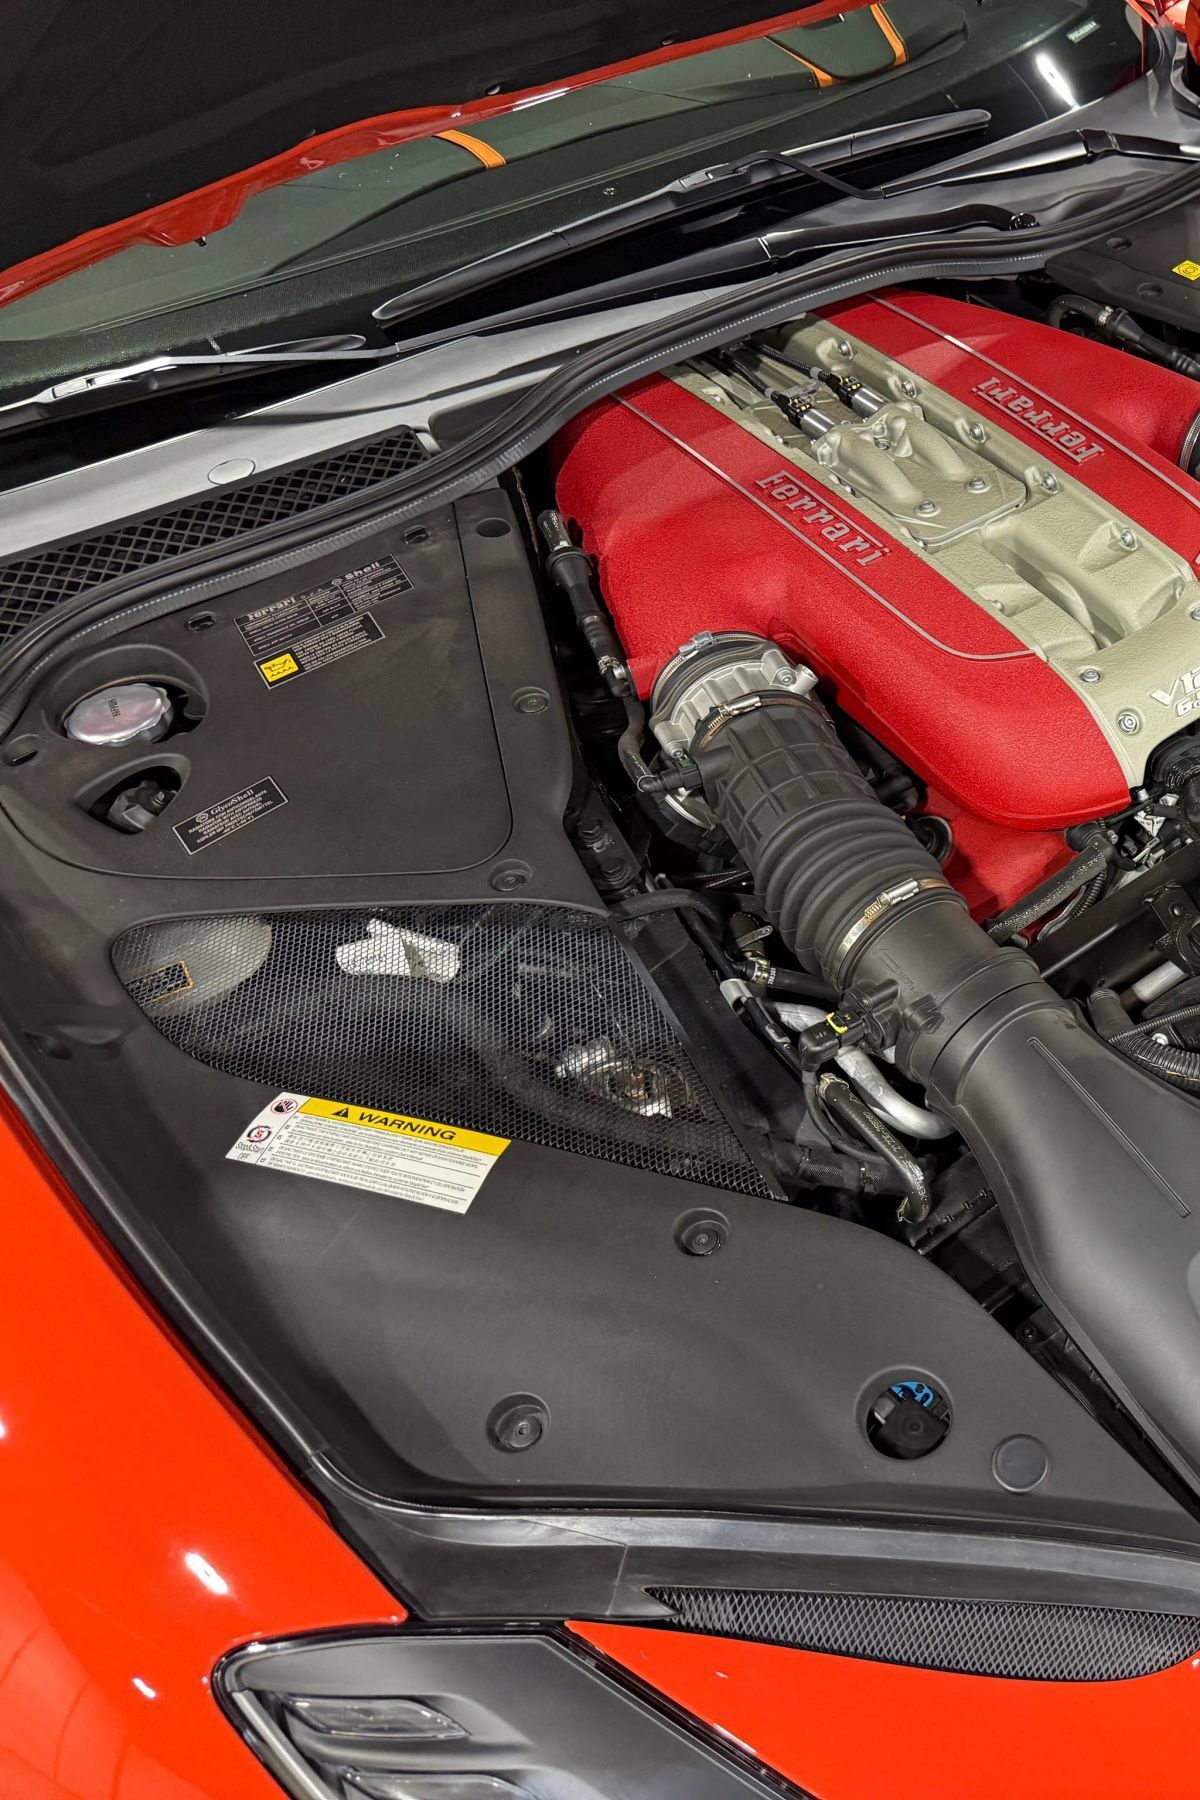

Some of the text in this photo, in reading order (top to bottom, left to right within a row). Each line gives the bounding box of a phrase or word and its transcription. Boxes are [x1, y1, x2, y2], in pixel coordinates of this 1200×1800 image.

[971, 375, 1103, 465] Ferrari
[755, 469, 890, 566] Ferrari
[345, 562, 380, 580] Shell
[246, 595, 296, 621] Ferrari
[209, 788, 254, 816] GlycoShell
[359, 1111, 457, 1142] WARNING
